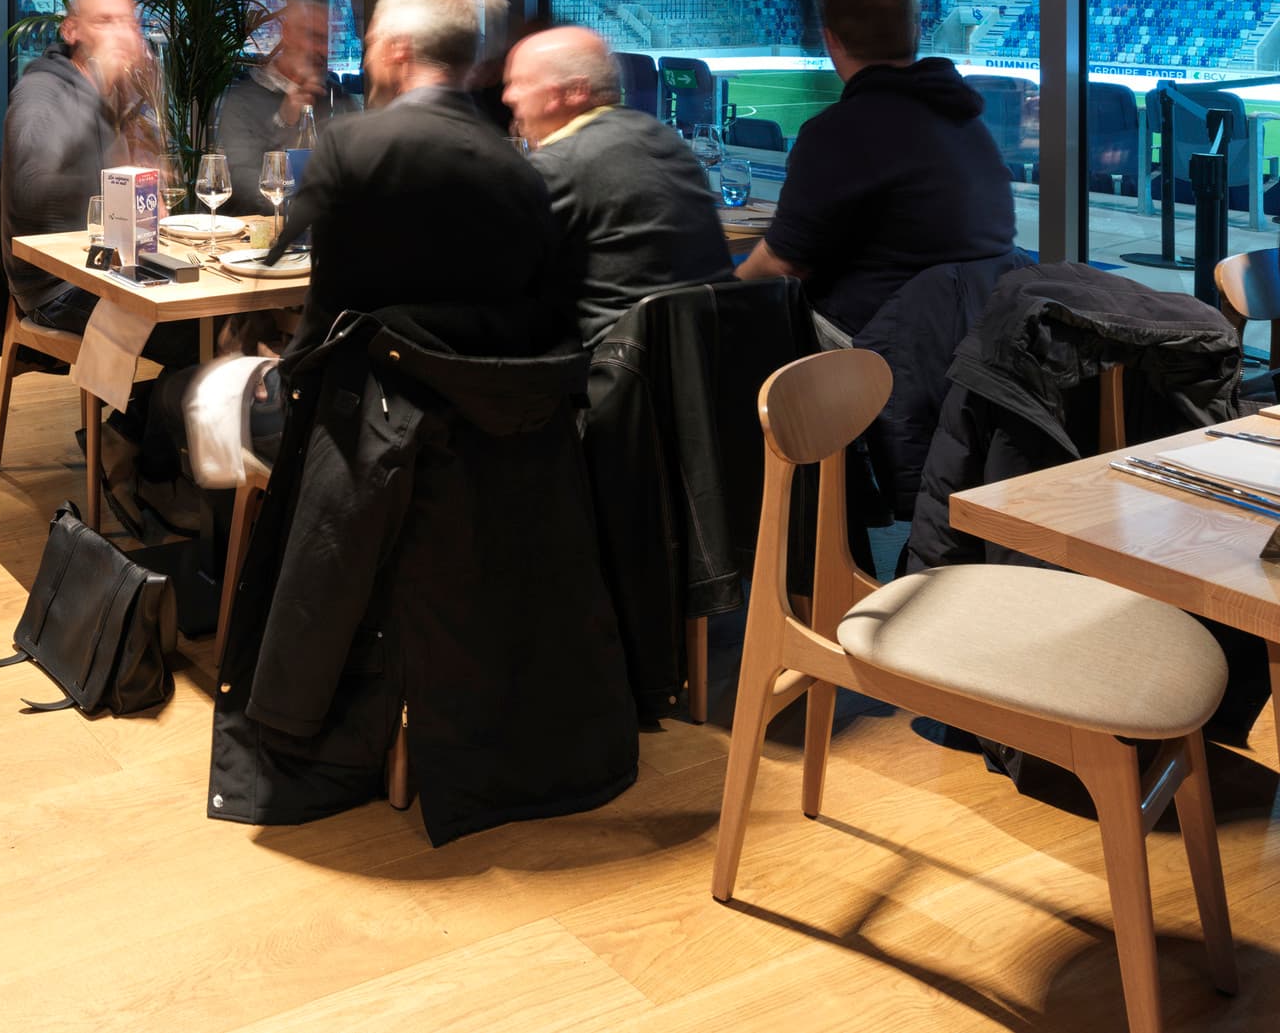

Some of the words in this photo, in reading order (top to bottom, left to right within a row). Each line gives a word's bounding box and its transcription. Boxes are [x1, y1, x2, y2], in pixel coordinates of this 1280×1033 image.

[1094, 66, 1140, 76] GROUPE
[1145, 69, 1185, 79] BADER
[1203, 72, 1226, 81] BCV
